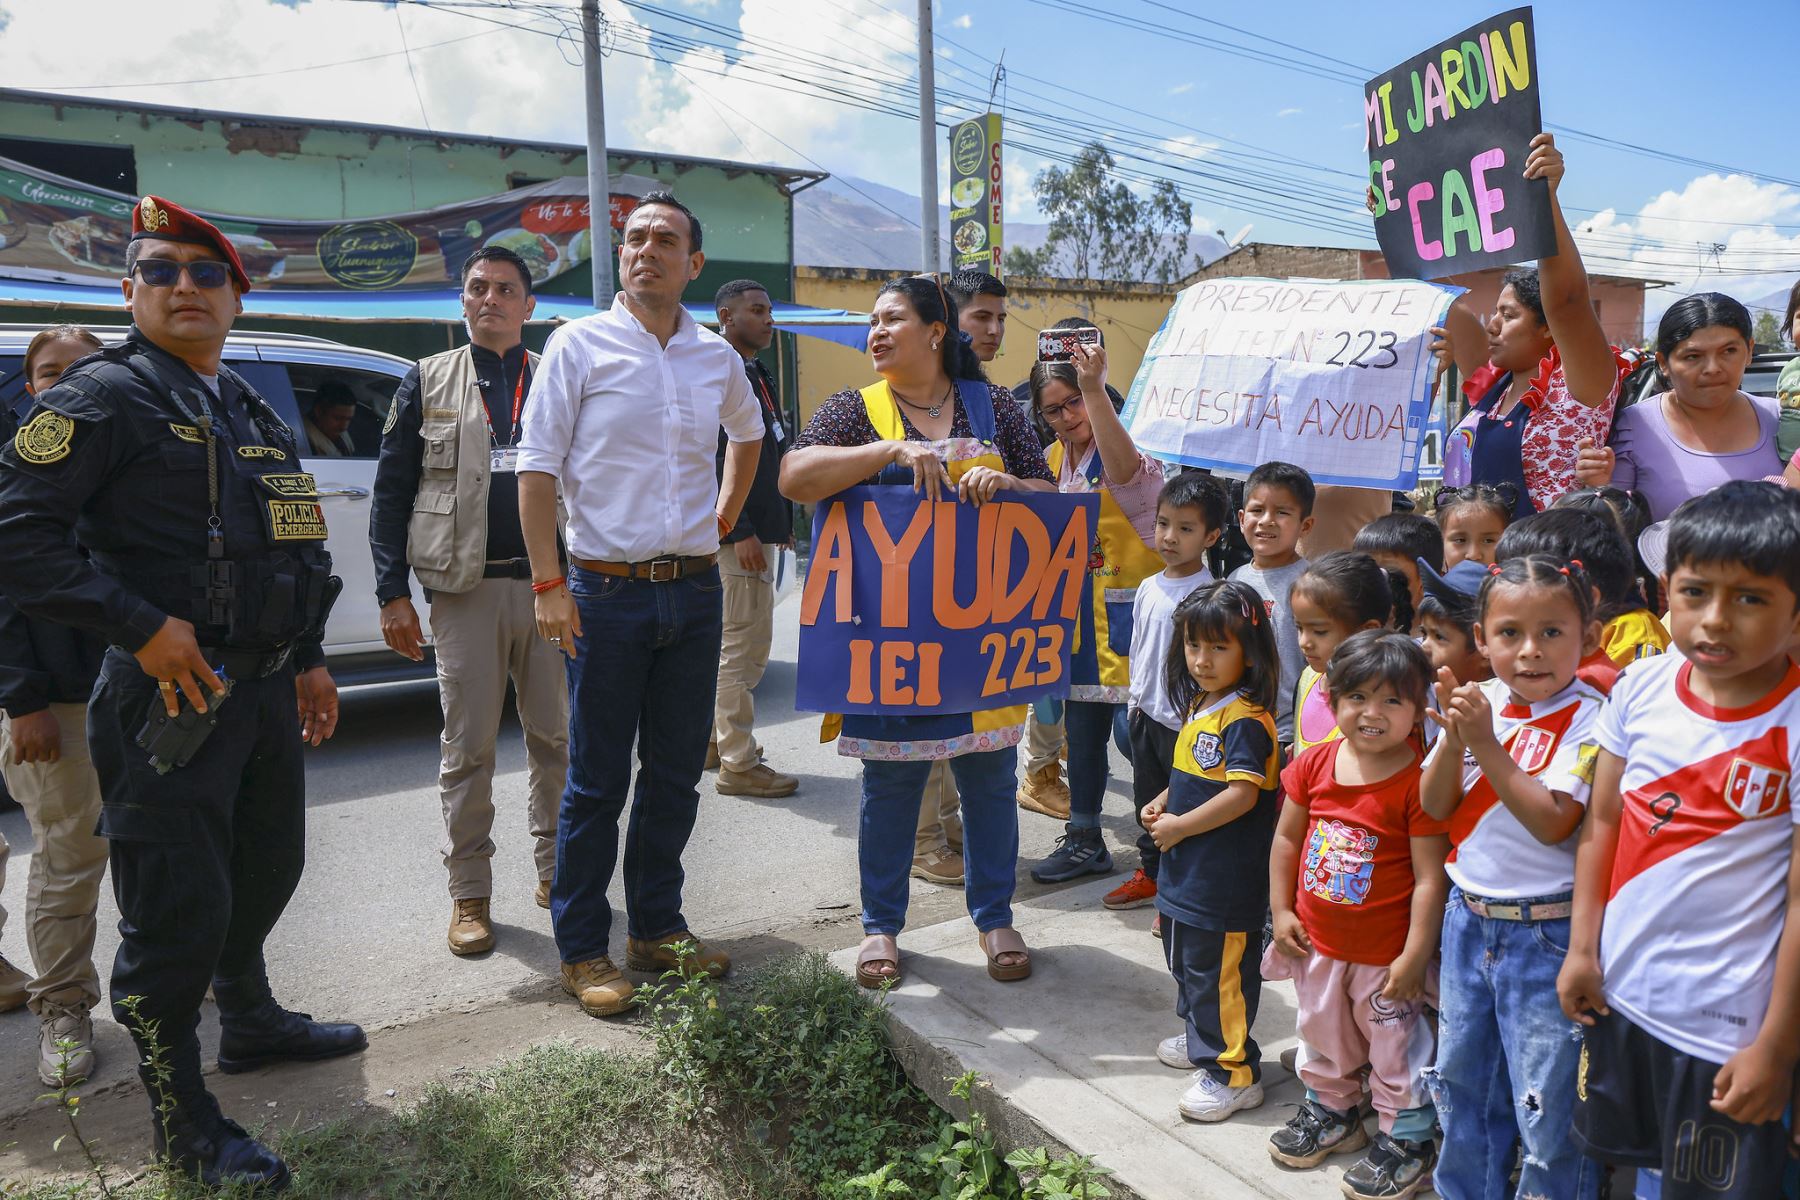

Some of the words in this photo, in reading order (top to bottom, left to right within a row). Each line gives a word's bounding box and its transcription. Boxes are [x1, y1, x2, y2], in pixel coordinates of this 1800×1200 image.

[1363, 81, 1399, 152] MI
[1407, 21, 1530, 133] JARDIN
[531, 203, 557, 220] No
[1369, 158, 1401, 218] SE
[1408, 148, 1516, 261] CAE
[1192, 284, 1422, 316] PRESIDENTE
[1170, 328, 1208, 358] LA
[1326, 329, 1399, 370] 223
[1143, 385, 1282, 433] NECESITA
[1298, 398, 1406, 442] AYUDA
[273, 504, 320, 523] POLICIA
[800, 499, 1088, 629] AYUDA
[846, 639, 943, 706] IEI
[980, 624, 1064, 698] 223
[1518, 739, 1546, 754] FPF
[1735, 778, 1776, 797] FPF
[1649, 791, 1682, 837] 9
[1672, 1119, 1739, 1192] 10
